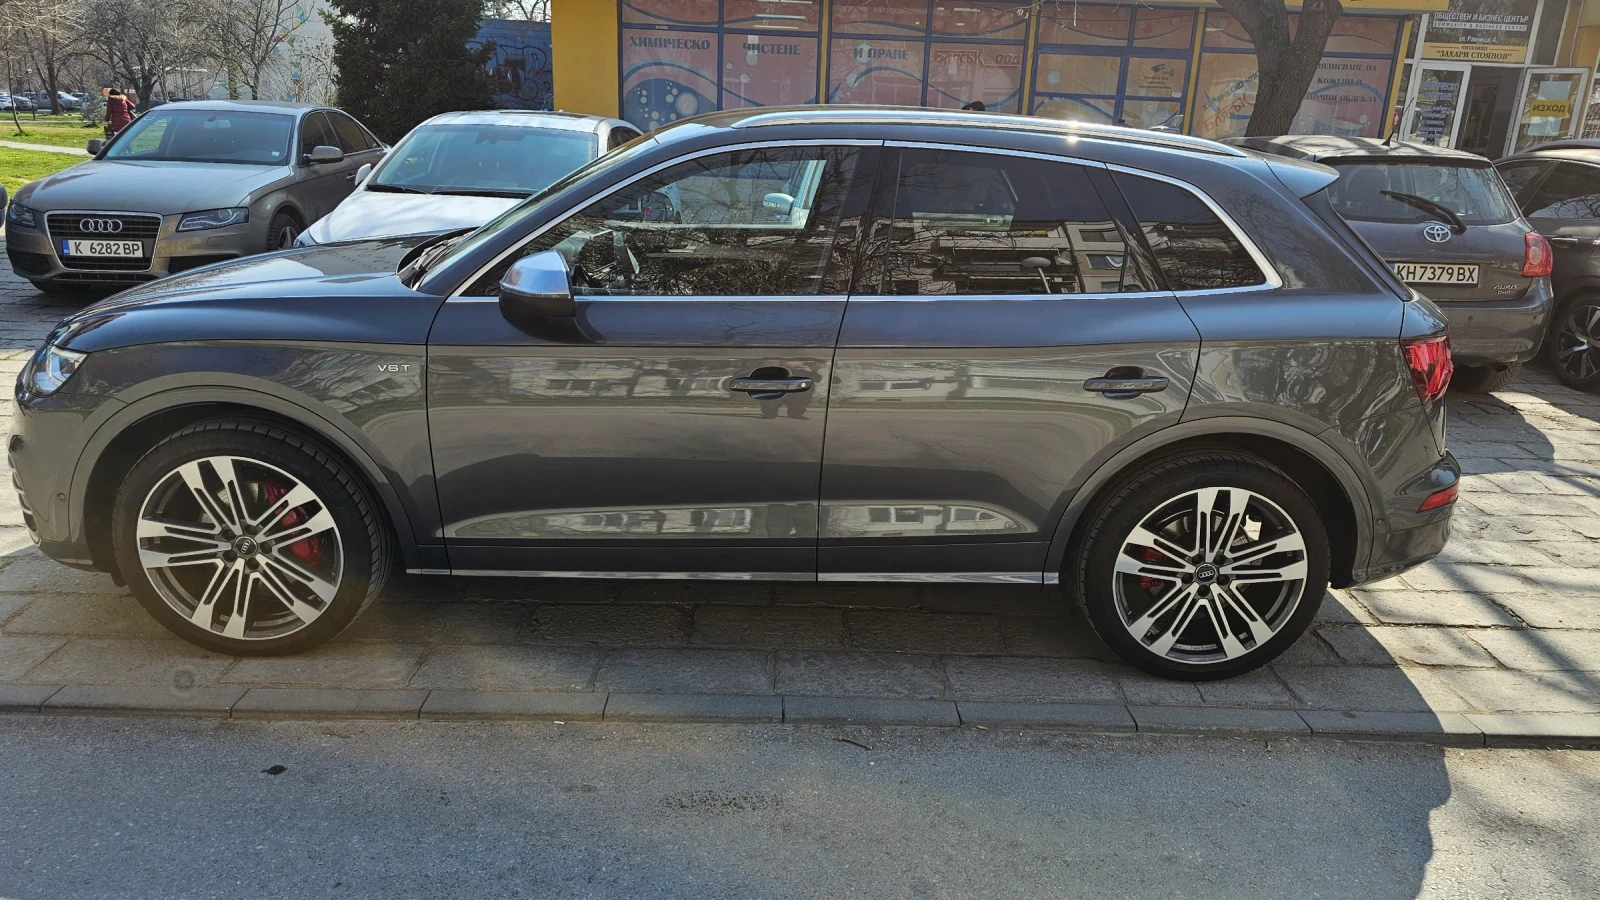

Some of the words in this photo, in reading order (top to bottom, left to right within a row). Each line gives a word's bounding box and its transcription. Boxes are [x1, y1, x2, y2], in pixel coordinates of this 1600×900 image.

[1435, 12, 1471, 21] ОБЩЕСТВЕН
[1479, 14, 1503, 22] БИЗНЕС
[1504, 15, 1529, 23] ЦЕНТЪР
[630, 36, 711, 50] ХИМИЧЕСКО
[743, 43, 801, 55] ЧИСТЕНЕ
[854, 47, 864, 59] И
[868, 48, 909, 60] ПРАНЕ
[1318, 62, 1362, 71] ЯДИСВАНЕ
[1366, 64, 1377, 72] НА
[1532, 104, 1566, 113] ИЗХОД
[377, 364, 411, 372] V6T
